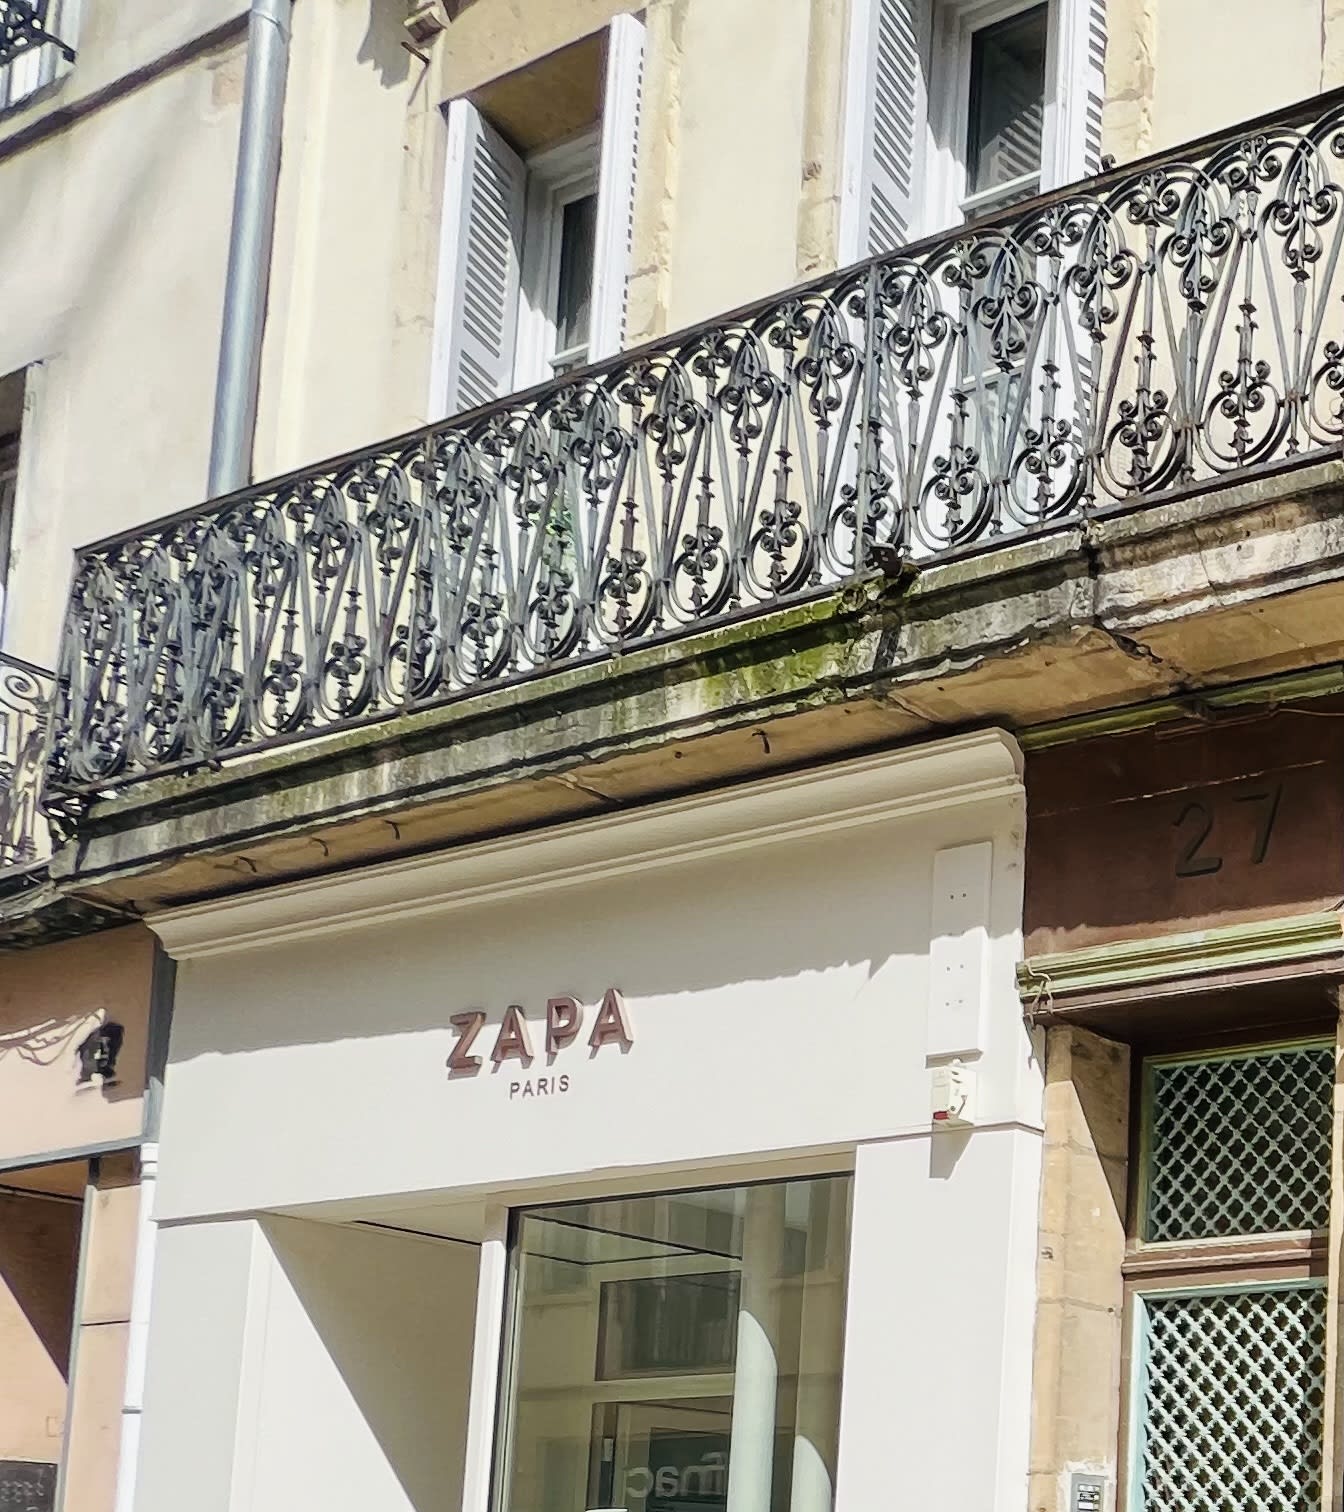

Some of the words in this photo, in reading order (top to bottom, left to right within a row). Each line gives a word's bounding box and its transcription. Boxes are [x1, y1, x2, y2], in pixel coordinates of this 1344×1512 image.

[1172, 781, 1283, 877] 27
[446, 988, 634, 1070] ZAPA
[509, 1074, 570, 1100] PARIS
